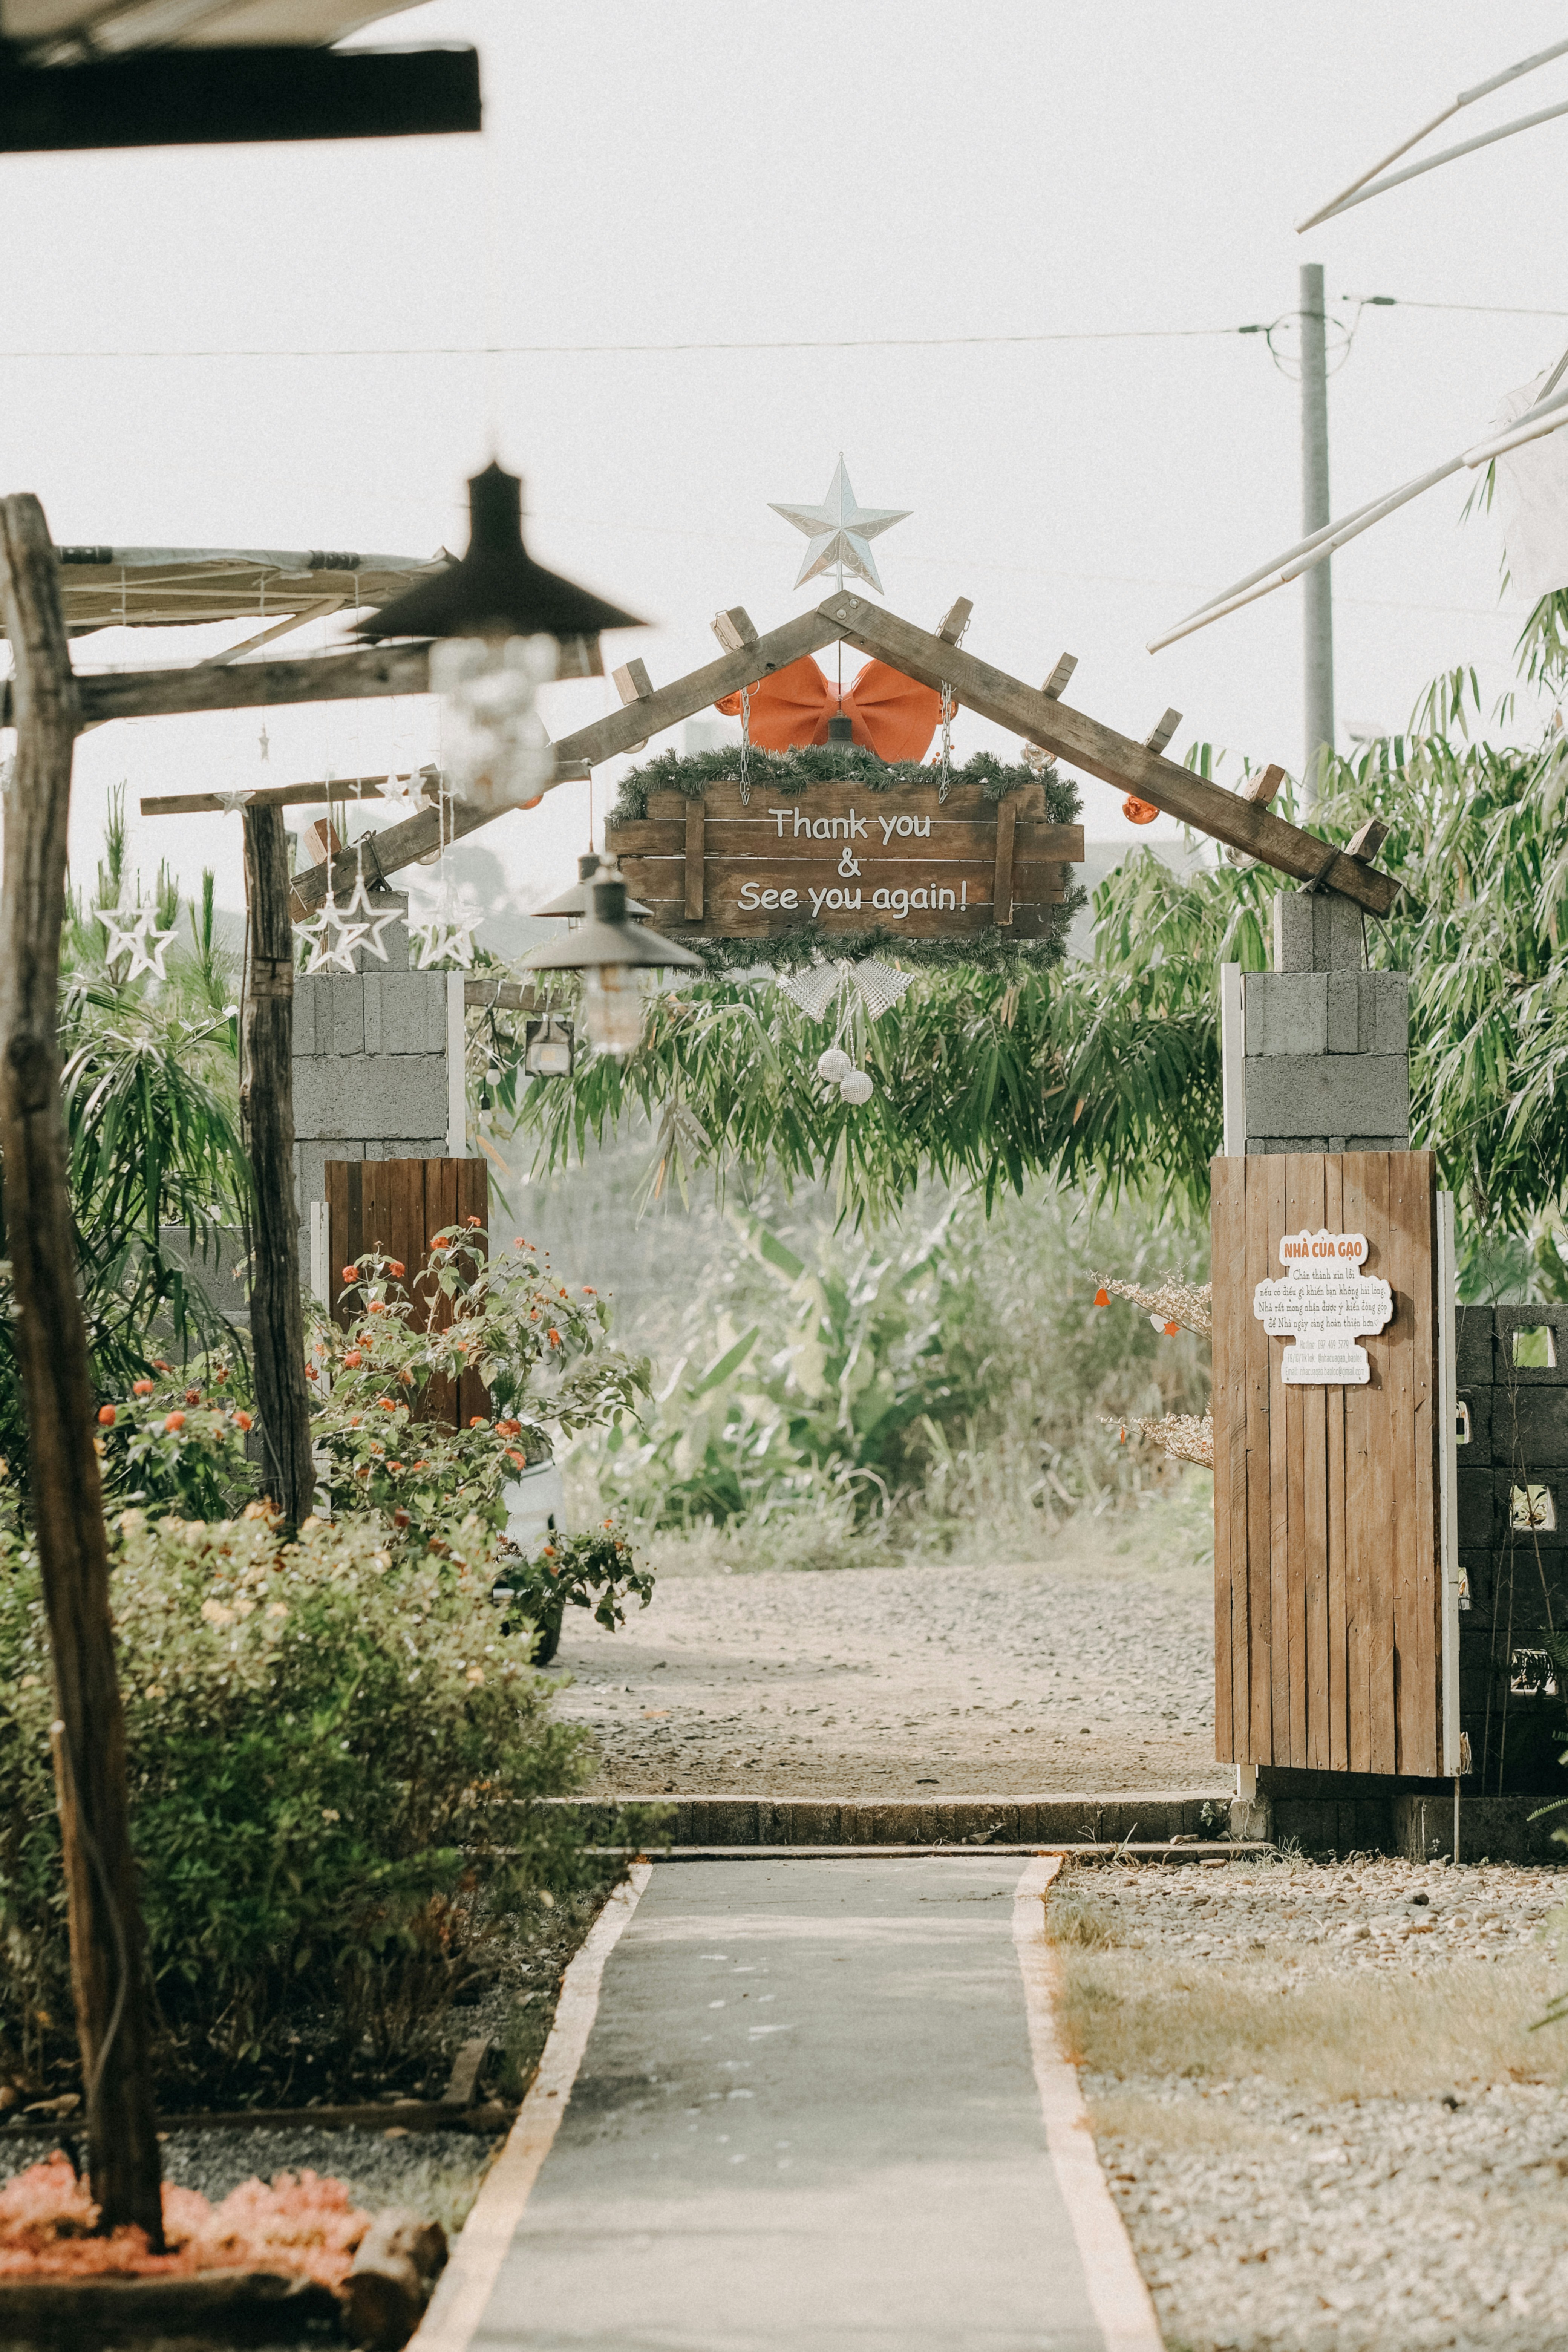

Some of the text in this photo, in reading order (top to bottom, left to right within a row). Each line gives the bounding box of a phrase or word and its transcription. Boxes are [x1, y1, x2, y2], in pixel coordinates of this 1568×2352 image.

[768, 807, 931, 846] Thank you
[838, 847, 861, 878] &
[737, 880, 967, 919] See you again!
[1285, 1237, 1362, 1261] NHÀ CỦA GẠO
[1293, 1268, 1355, 1280] Chân thành xin lỗi
[1260, 1283, 1386, 1300] nếu có điều gì khiến bạn không hài lòng.
[1258, 1300, 1387, 1315] Nhà rất mong nhận được ý kiến đóng góp
[1268, 1317, 1276, 1328] để
[1278, 1317, 1291, 1328] Nhà
[1294, 1319, 1309, 1332] ngày
[1310, 1318, 1324, 1331] càng
[1326, 1316, 1341, 1327] hoàn
[1344, 1316, 1360, 1329] thiện
[1300, 1340, 1316, 1349] Hotline:
[1338, 1340, 1349, 1349] 3779
[1287, 1354, 1316, 1363] FB/IG/TikTok:
[1285, 1367, 1298, 1376] Email:
